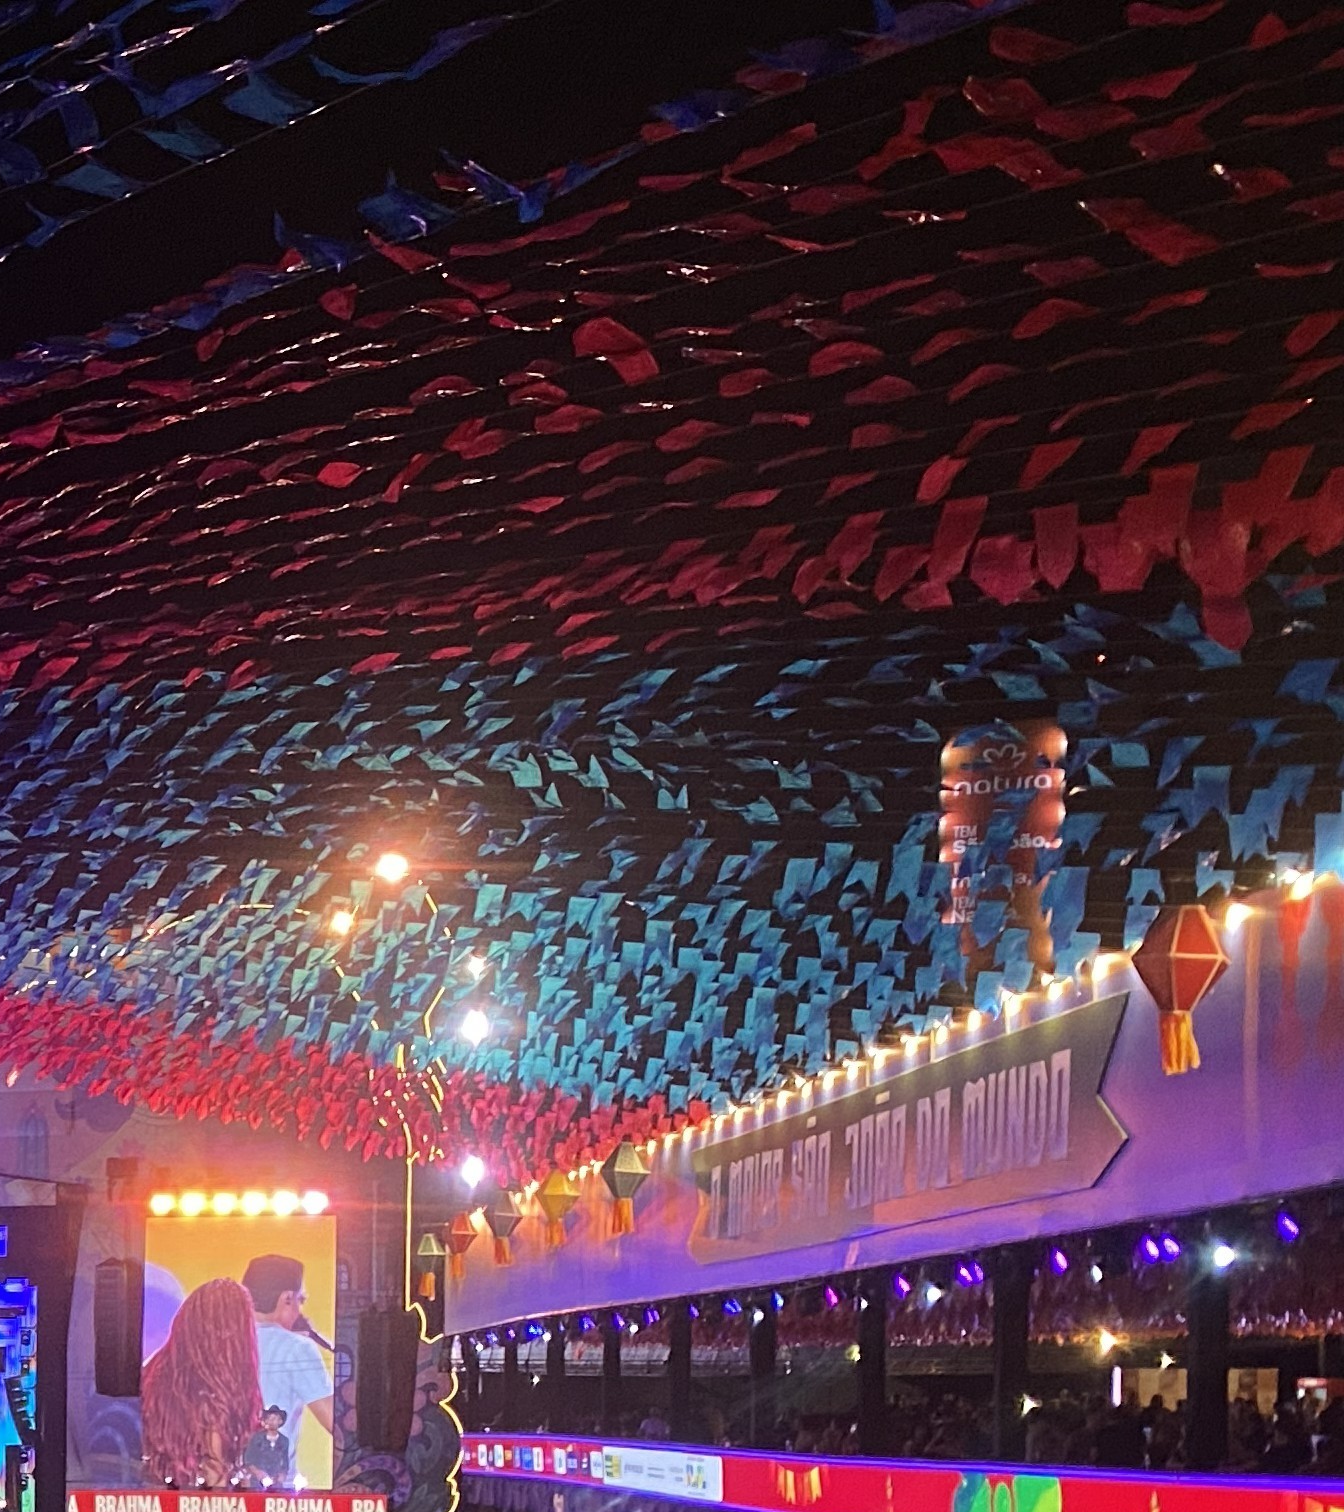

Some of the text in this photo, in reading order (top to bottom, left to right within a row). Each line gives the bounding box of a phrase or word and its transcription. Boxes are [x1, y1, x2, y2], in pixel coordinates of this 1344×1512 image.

[952, 774, 1053, 797] natura
[791, 1116, 831, 1221] SÃO
[845, 1092, 907, 1210] JOÃO
[962, 1049, 1072, 1181] MUNDO
